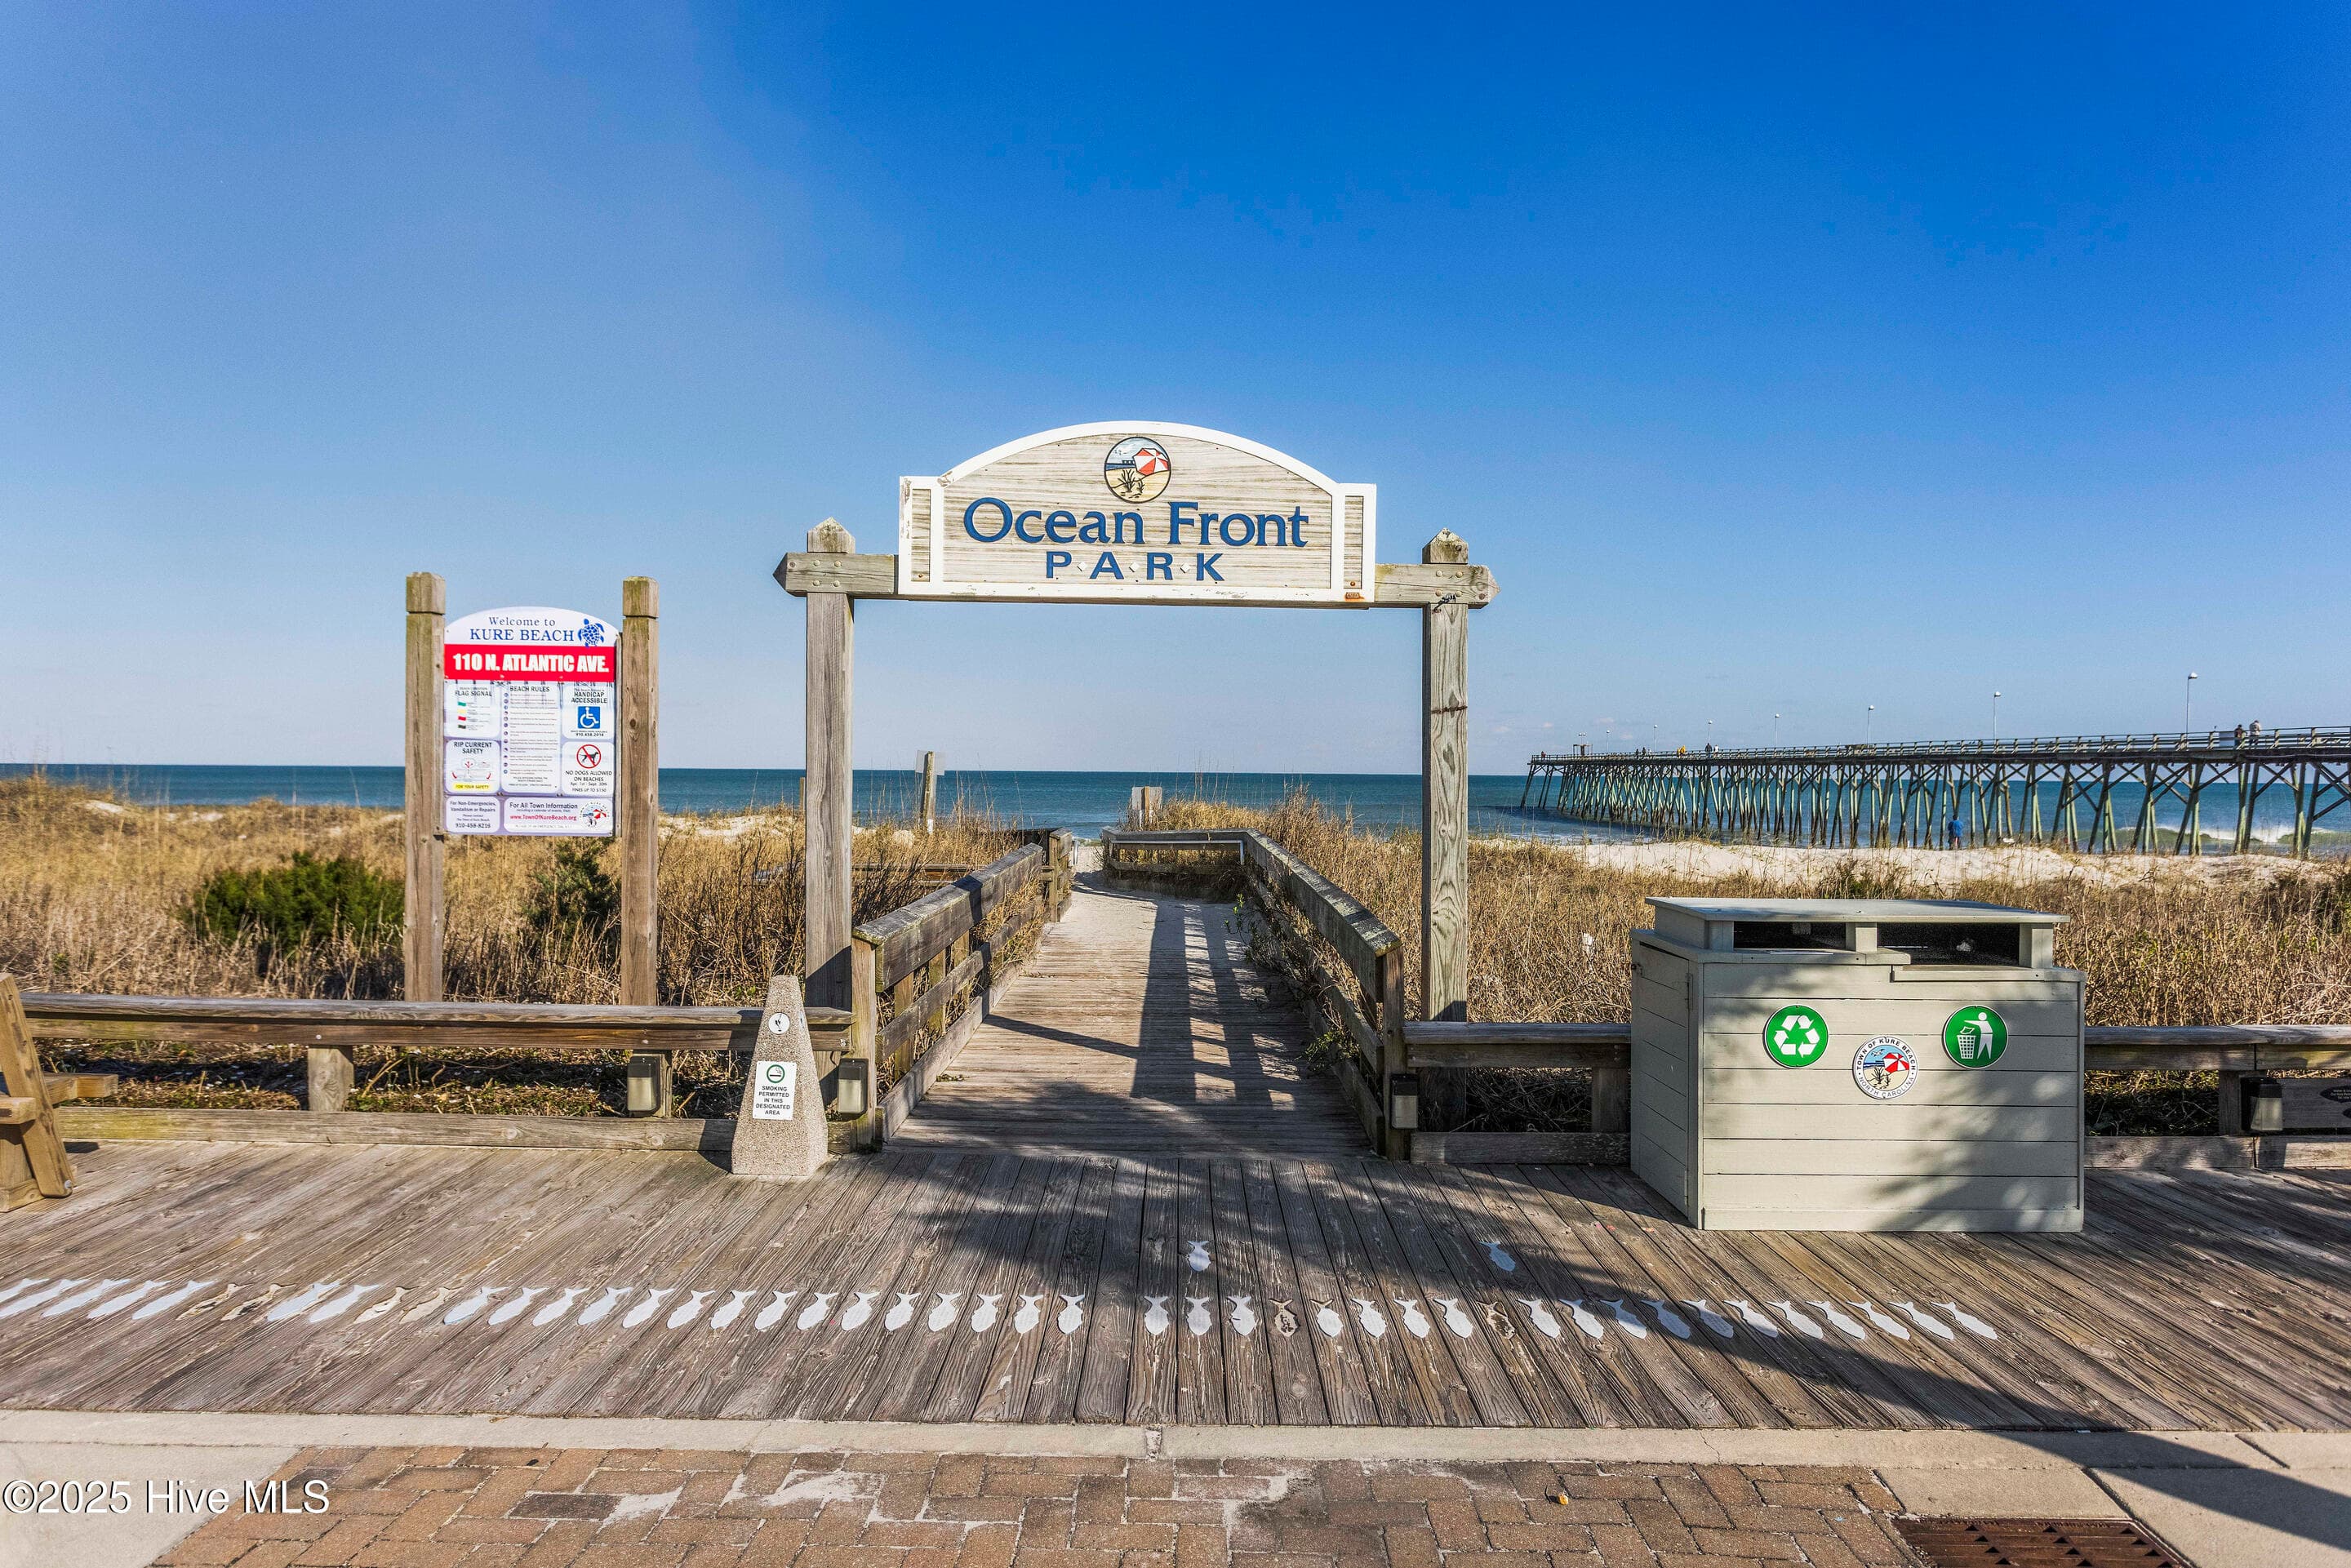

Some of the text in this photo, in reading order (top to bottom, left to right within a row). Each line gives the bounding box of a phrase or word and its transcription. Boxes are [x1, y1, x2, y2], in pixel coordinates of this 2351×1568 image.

[963, 496, 1309, 548] Ocean Front
[1046, 550, 1224, 582] PARK
[489, 617, 556, 627] Welcome to
[470, 629, 575, 642] KURE BEACH
[453, 653, 609, 673] 110 N. ATLANTIC AVE.
[1856, 1038, 1916, 1071] TOWN OF KURE BEACH
[1859, 1077, 1914, 1098] NORTH CAROLINA
